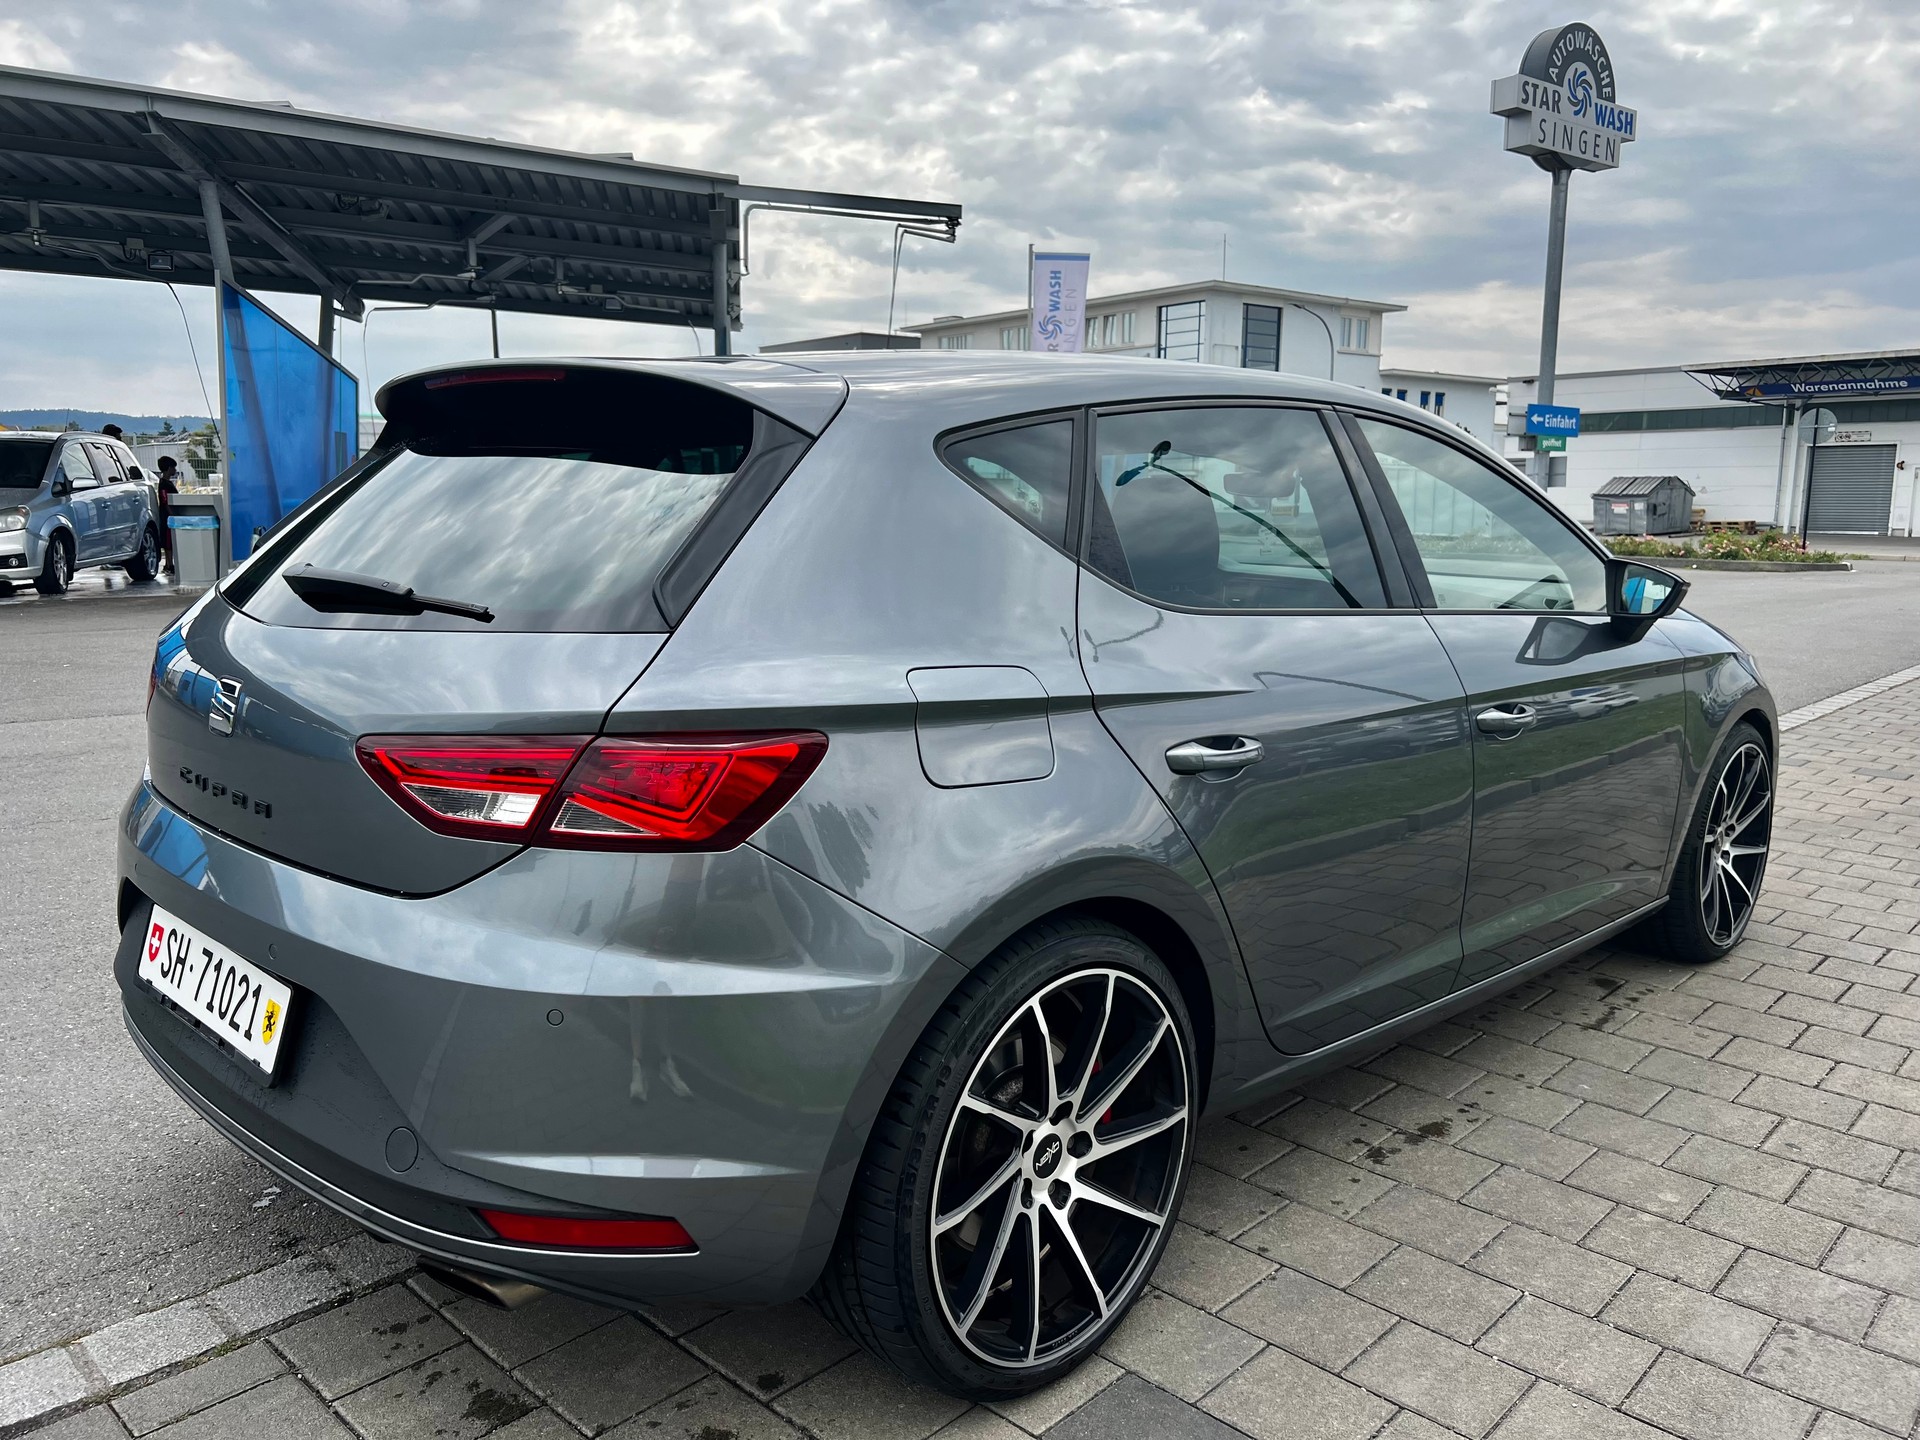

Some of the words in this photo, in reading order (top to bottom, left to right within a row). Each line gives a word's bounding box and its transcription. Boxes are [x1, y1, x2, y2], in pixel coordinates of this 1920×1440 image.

[1549, 30, 1612, 98] AUTOWÄSCHE
[1521, 80, 1561, 114] STAR
[1594, 102, 1634, 135] WASH
[1538, 118, 1616, 163] SINGEN
[1049, 270, 1062, 312] WASH
[1063, 288, 1077, 353] INGEN
[1791, 379, 1908, 393] Warenannahme
[1544, 414, 1577, 429] Einfahrt
[1542, 438, 1562, 449] geöffnet
